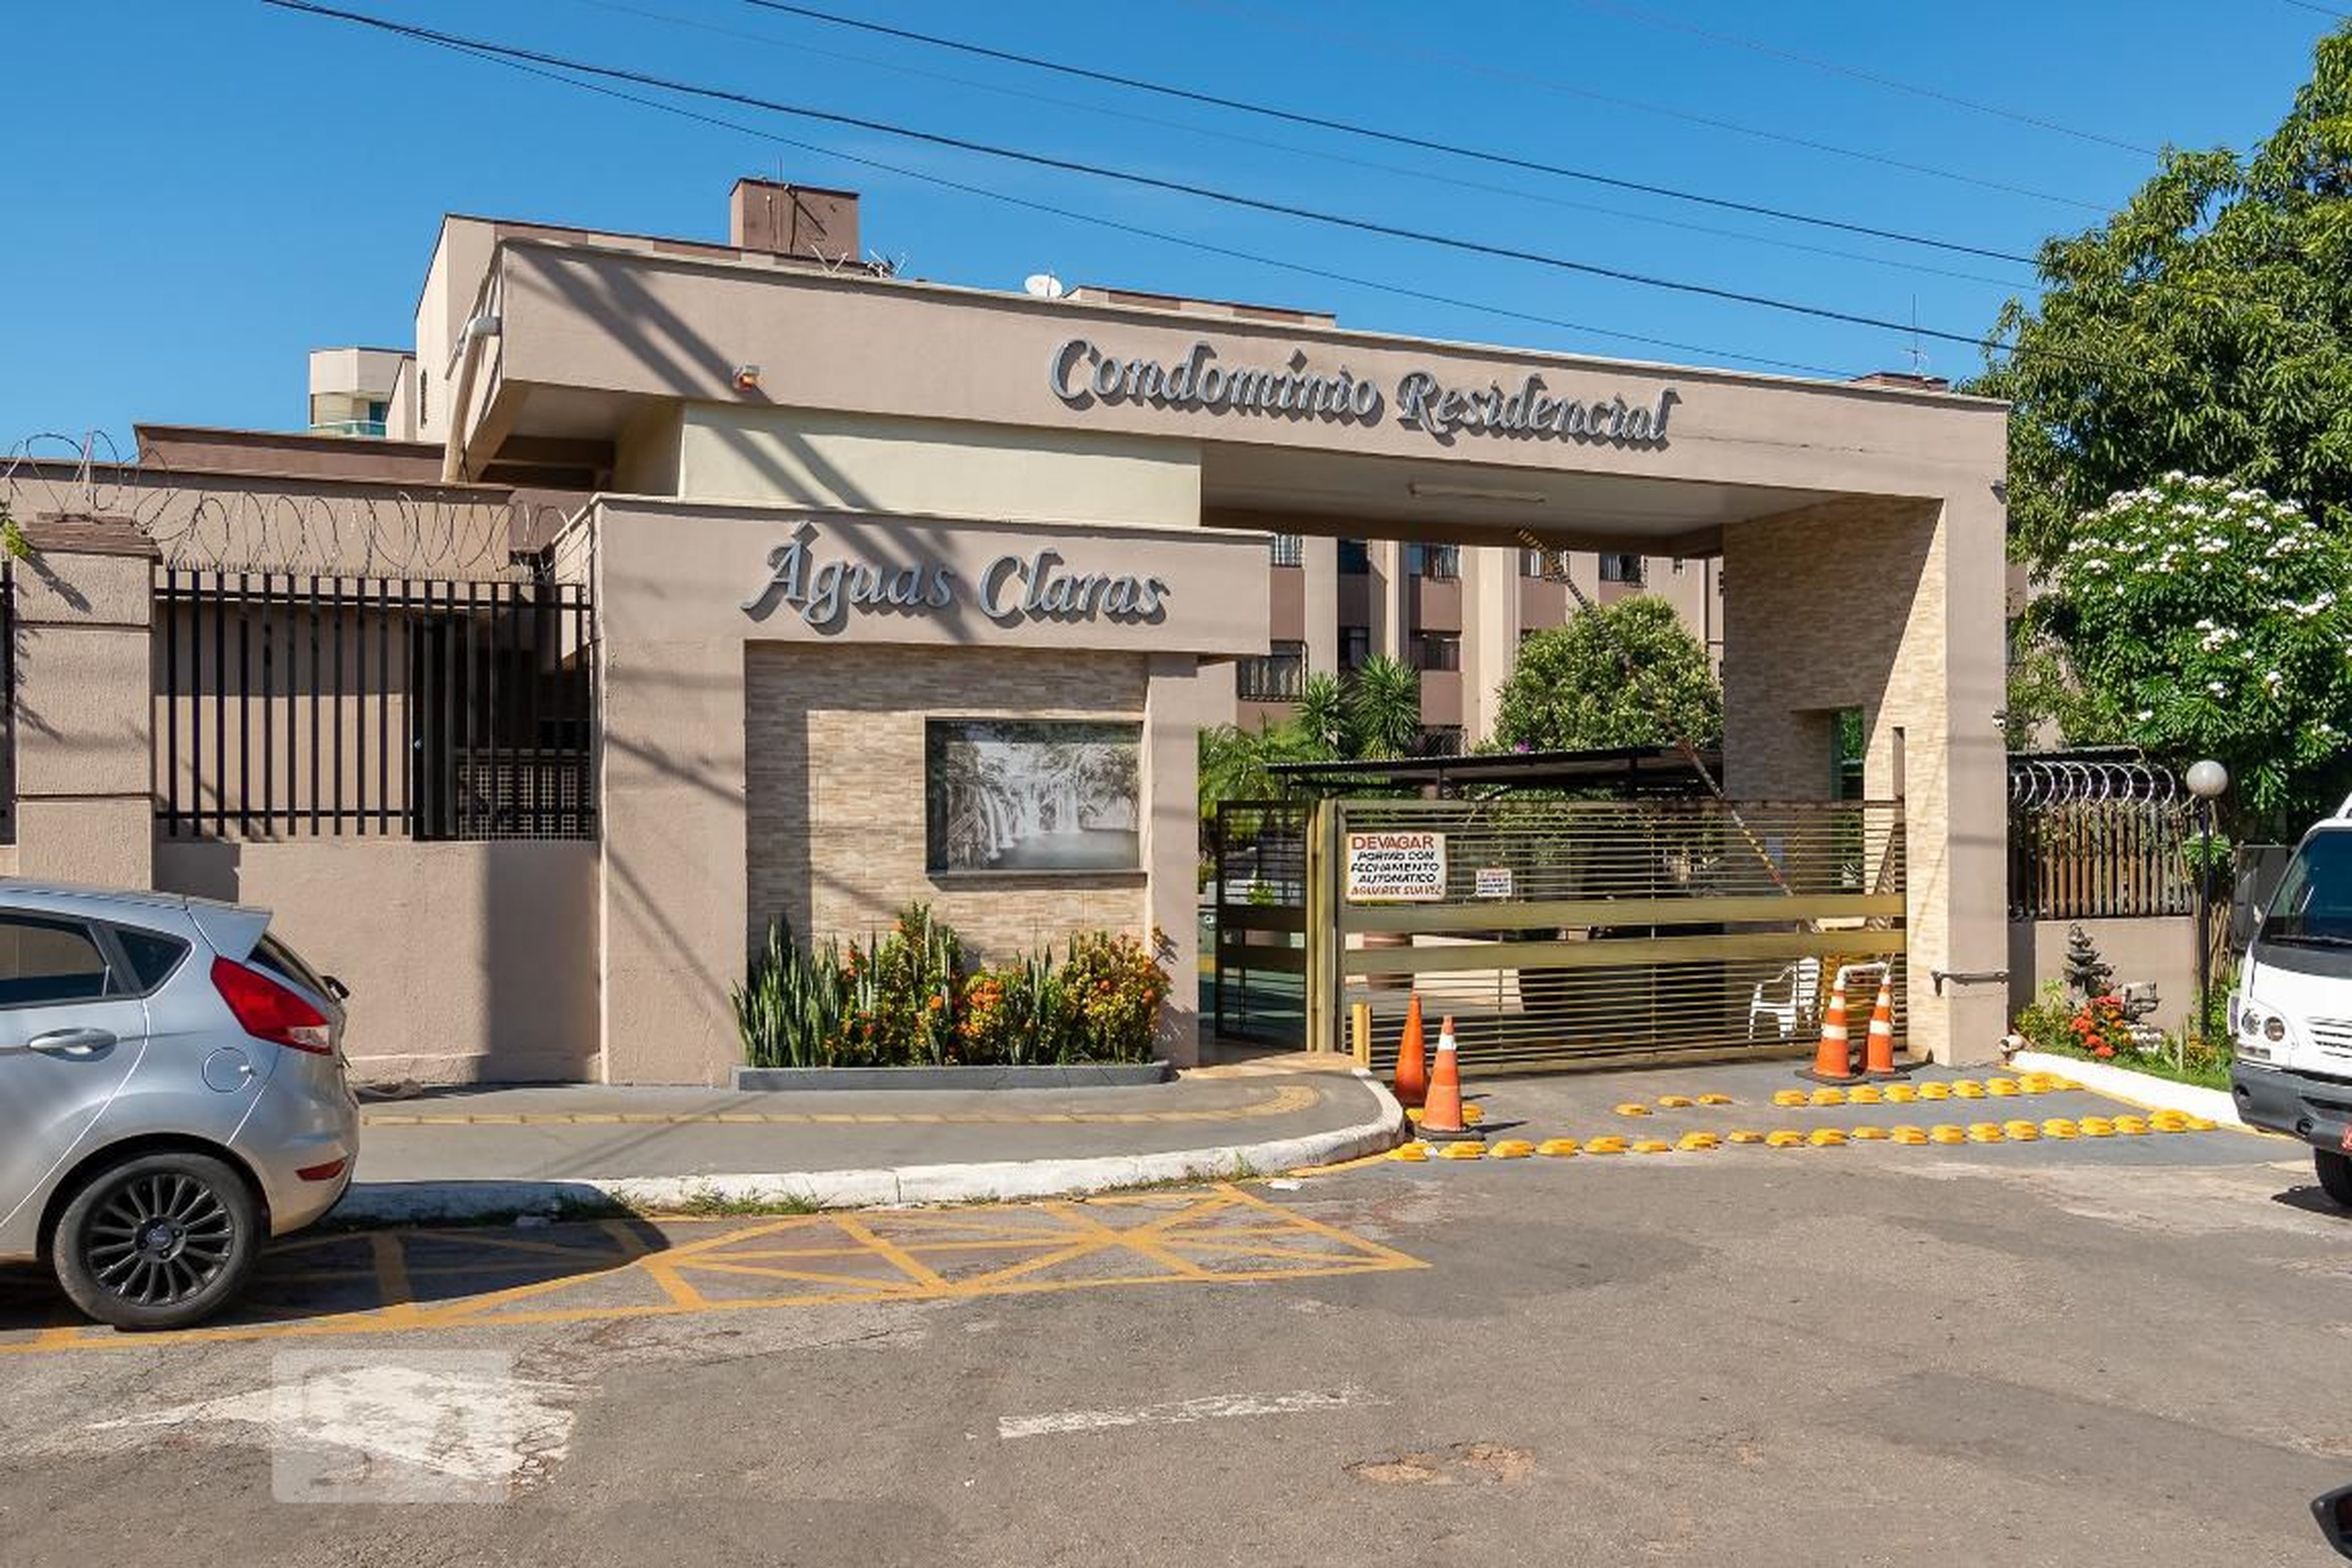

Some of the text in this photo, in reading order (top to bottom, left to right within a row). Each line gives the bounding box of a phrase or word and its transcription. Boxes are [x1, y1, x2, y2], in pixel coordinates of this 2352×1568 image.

[1396, 368, 1681, 447] Residencial
[741, 522, 1171, 635] Águas Claras
[1352, 835, 1434, 850] DEVAGAR
[1351, 862, 1440, 873] FECHAMENTO
